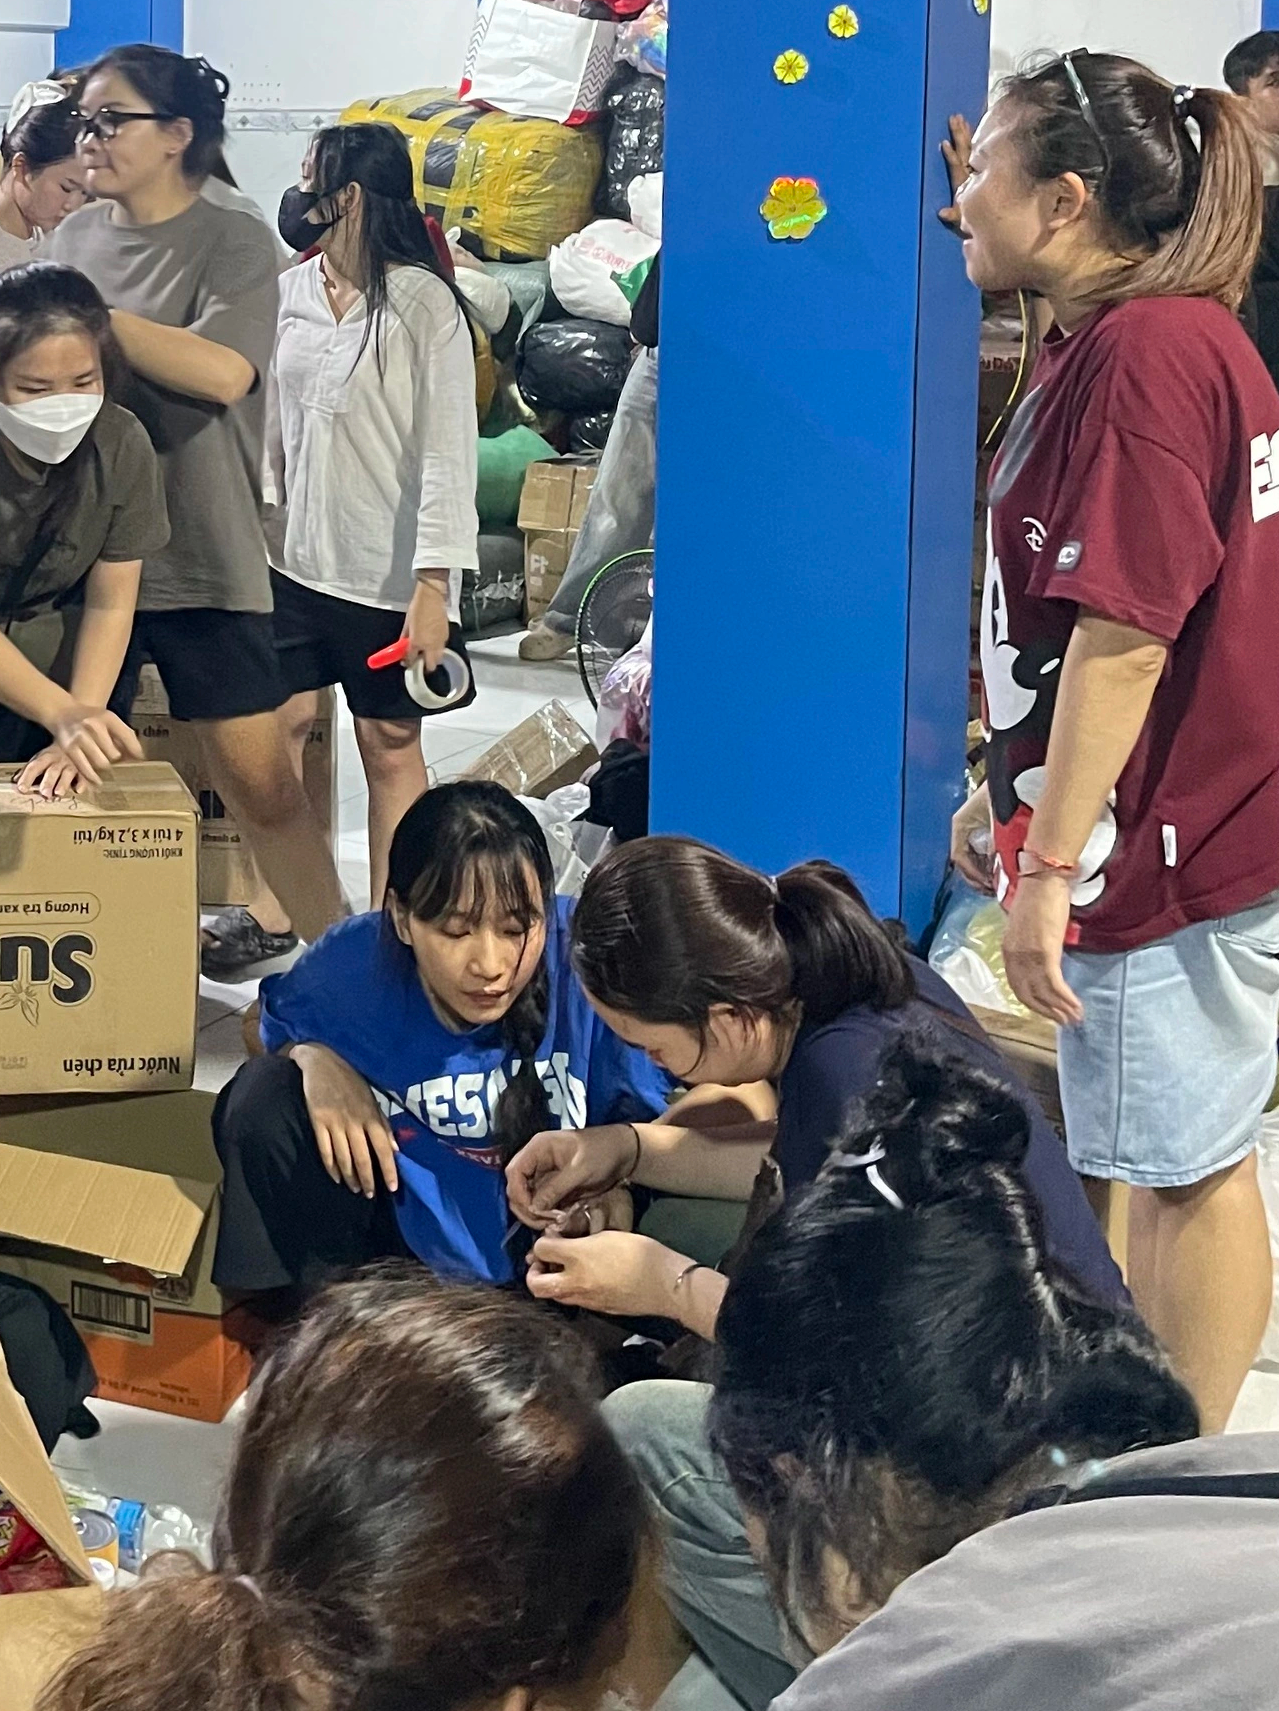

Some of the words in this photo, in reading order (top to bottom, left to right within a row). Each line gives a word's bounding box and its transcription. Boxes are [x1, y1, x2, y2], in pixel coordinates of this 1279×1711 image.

[73, 826, 115, 844] kg/túi
[117, 826, 140, 842] 3,2
[141, 830, 150, 840] x
[153, 829, 172, 844] túi
[175, 829, 184, 842] 4
[22, 903, 42, 916] trà
[45, 900, 90, 916] Hương
[63, 1058, 103, 1076] chén
[106, 1057, 136, 1077] rửa
[138, 1056, 180, 1075] Nước
